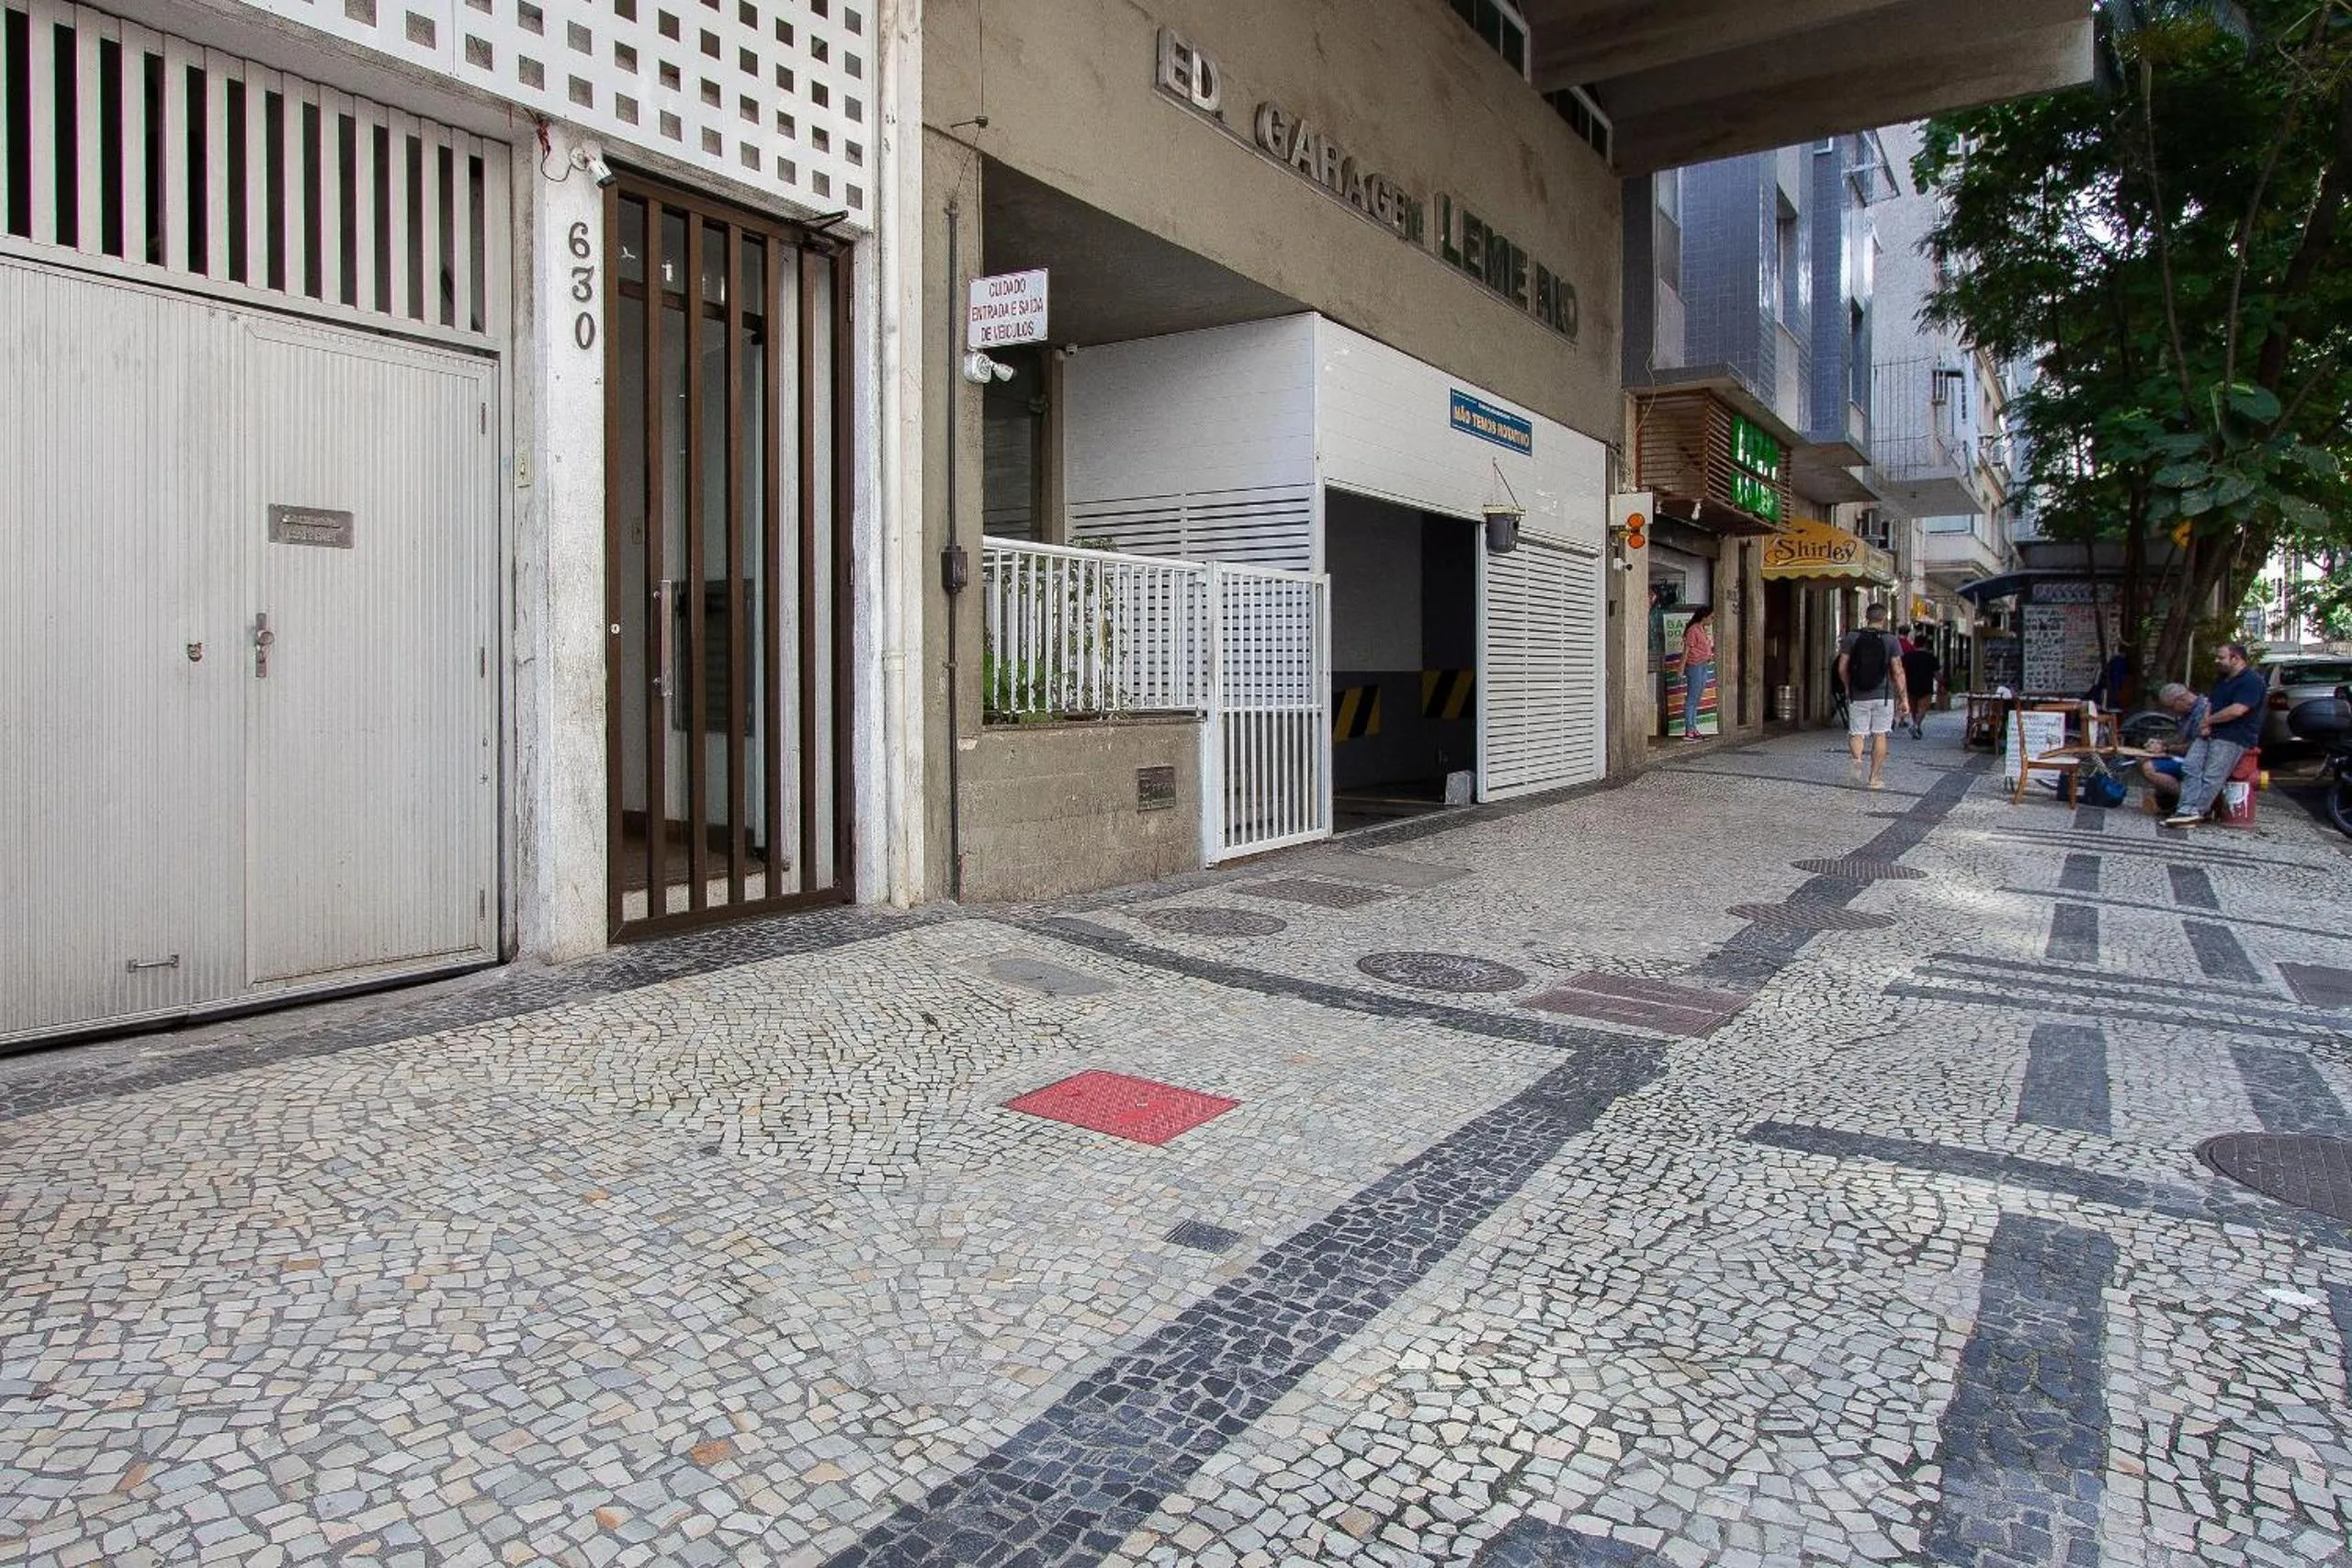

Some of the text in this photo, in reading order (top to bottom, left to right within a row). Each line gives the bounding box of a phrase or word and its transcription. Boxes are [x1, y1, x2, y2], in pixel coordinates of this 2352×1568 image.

[1255, 101, 1423, 245] GARAGEM
[1433, 192, 1529, 310] LEME
[569, 221, 595, 350] 630
[989, 278, 1026, 297] CUIDADO
[972, 304, 1009, 321] ENTRADA
[1011, 301, 1017, 316] E
[980, 327, 991, 342] DE
[1472, 413, 1497, 434] TEMOS
[1764, 537, 1857, 564] Shirley
